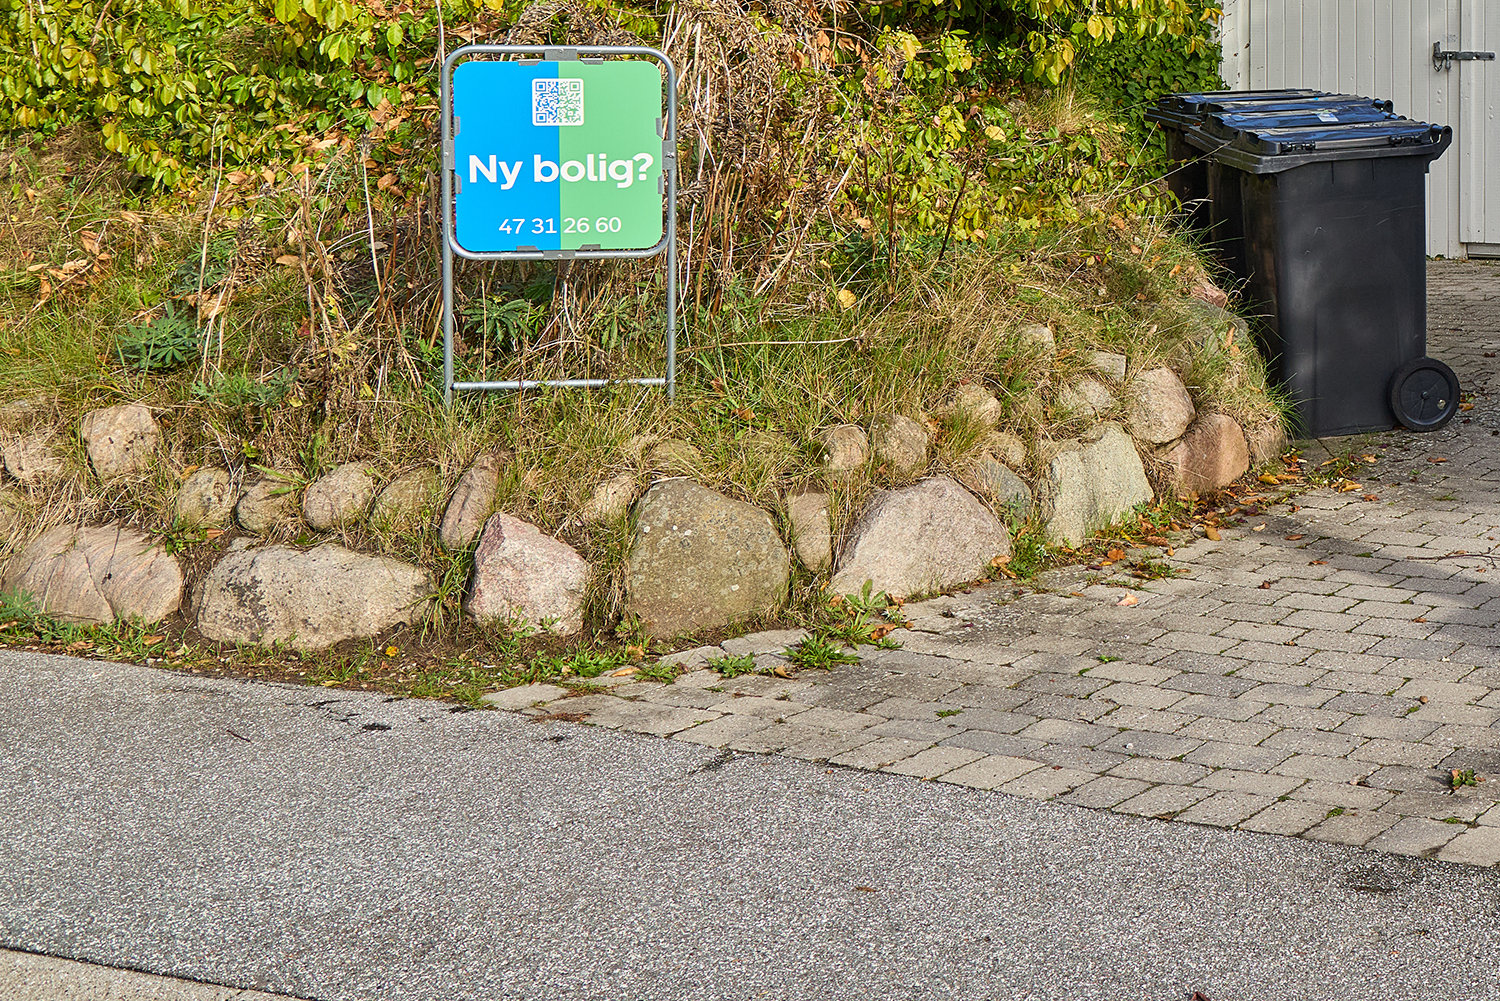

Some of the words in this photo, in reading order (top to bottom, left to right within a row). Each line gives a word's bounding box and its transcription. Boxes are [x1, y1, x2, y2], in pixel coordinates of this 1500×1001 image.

[469, 154, 523, 190] Ny
[533, 152, 654, 189] bolig?
[498, 218, 525, 235] 47
[531, 218, 557, 234] 31
[563, 217, 590, 234] 26
[595, 216, 622, 233] 60
